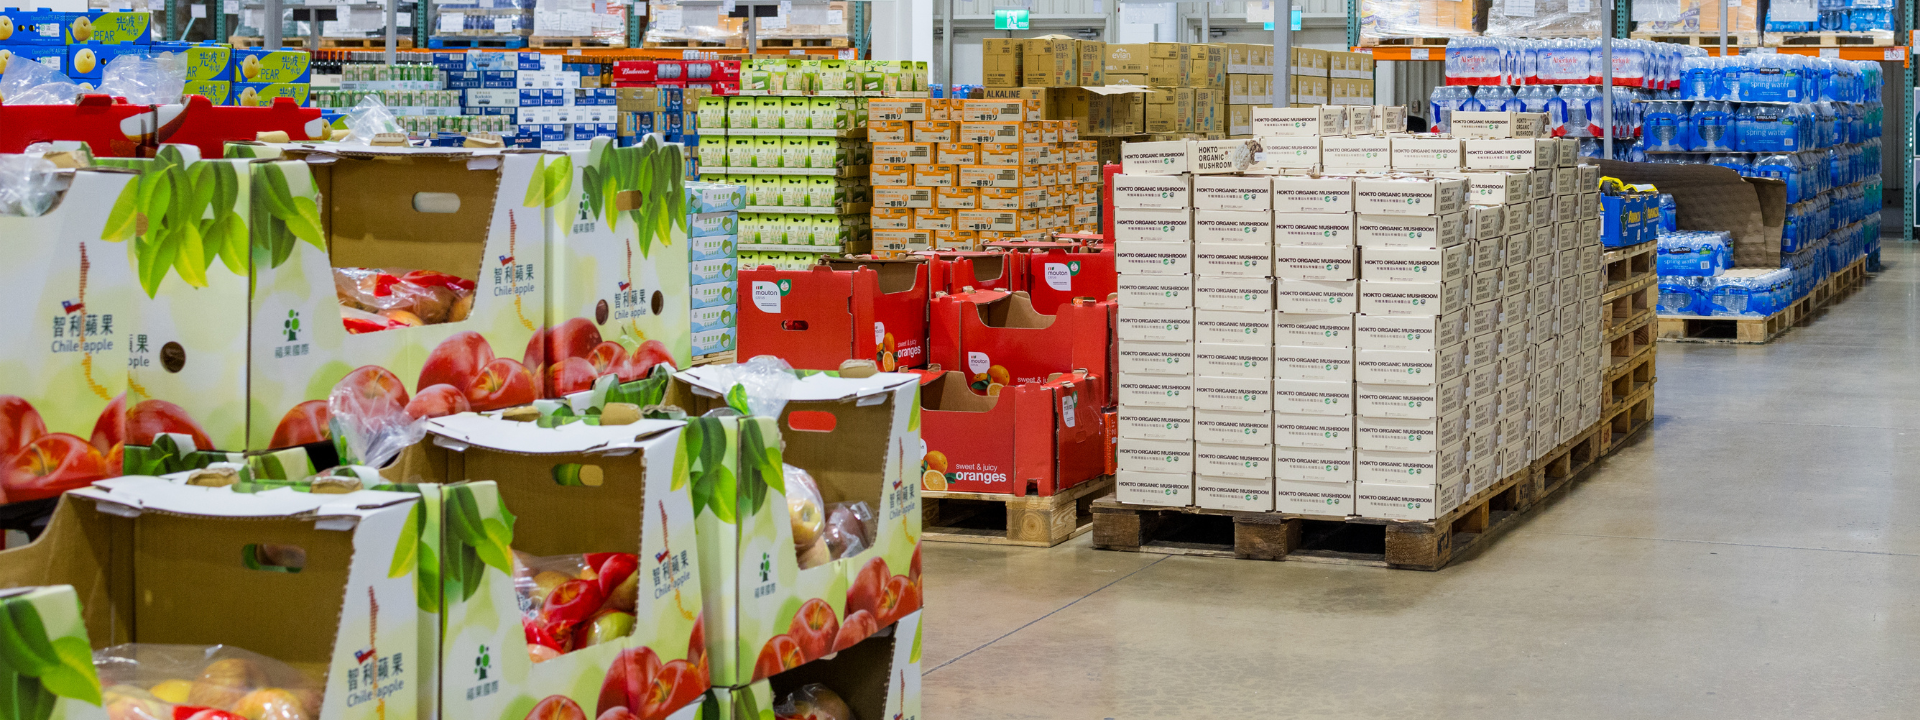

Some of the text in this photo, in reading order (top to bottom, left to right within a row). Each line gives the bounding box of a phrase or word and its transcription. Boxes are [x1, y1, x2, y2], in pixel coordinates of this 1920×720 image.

[116, 16, 135, 32] 光波
[94, 30, 114, 42] PEAR
[199, 51, 218, 67] 光波
[281, 55, 298, 70] 光波
[261, 69, 279, 80] PEAR
[494, 264, 534, 285] 智利蘋果
[494, 283, 535, 296] Chile apple
[630, 307, 646, 318] apple
[53, 314, 113, 338] 智利蘋果
[52, 339, 113, 354] Chile apple
[898, 346, 921, 358] oranges
[982, 463, 998, 472] juicy
[956, 471, 1007, 484] oranges
[653, 550, 689, 586] 智利蘋果
[655, 571, 690, 599] Chile apple
[348, 653, 403, 691] 智利蘋果
[347, 679, 404, 707] Chile apple
